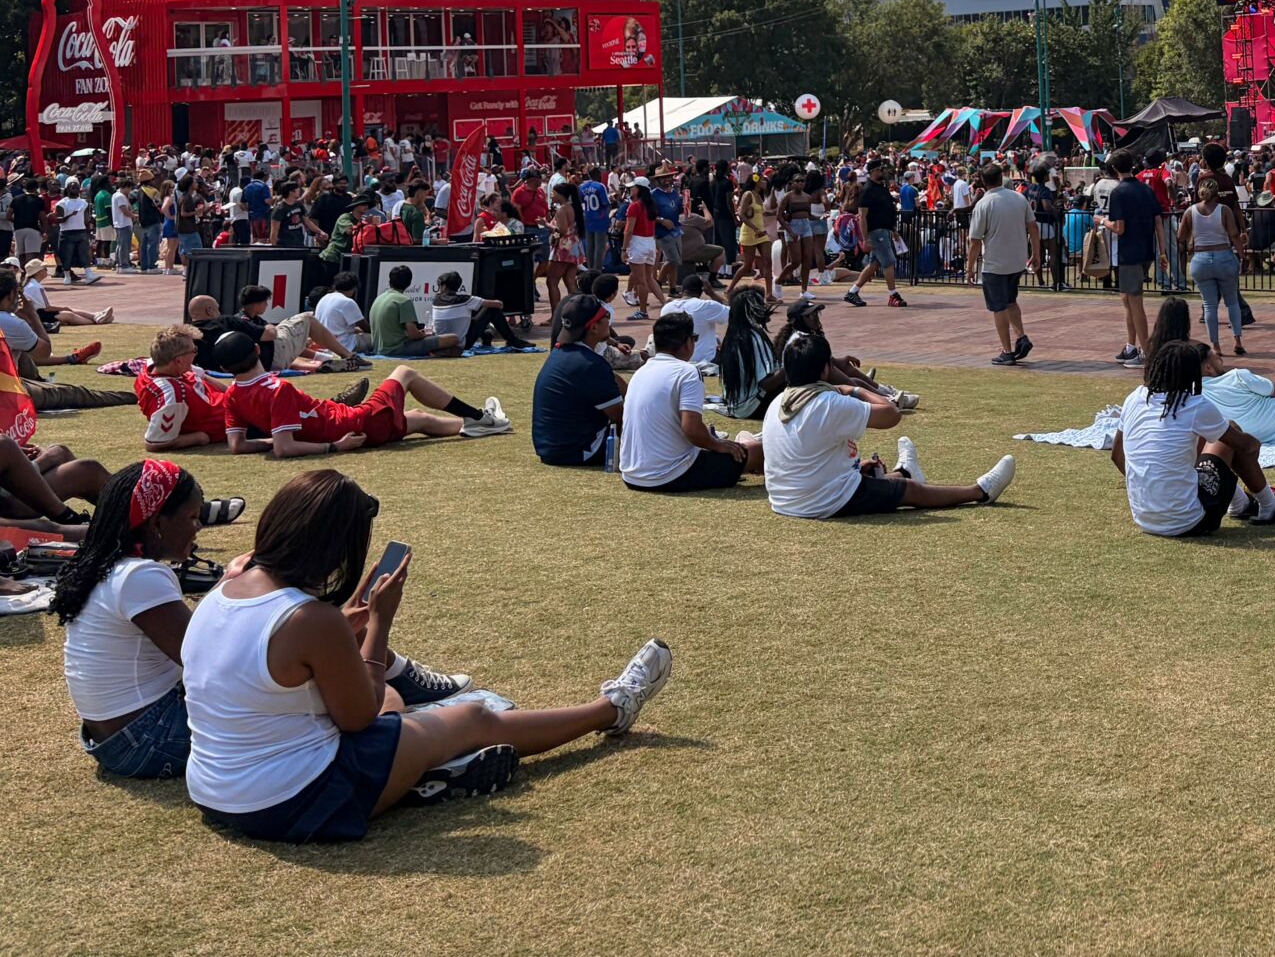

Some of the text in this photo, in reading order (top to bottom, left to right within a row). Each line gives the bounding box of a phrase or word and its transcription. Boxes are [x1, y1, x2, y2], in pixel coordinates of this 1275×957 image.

[57, 15, 139, 72] CocaCola
[610, 55, 638, 65] Seattle
[75, 78, 92, 94] FAN
[43, 100, 109, 125] Coca-Cola
[744, 120, 785, 133] DRINKS
[457, 153, 478, 218] Coca-Cola
[584, 194, 600, 211] 10
[1100, 195, 1108, 209] 7
